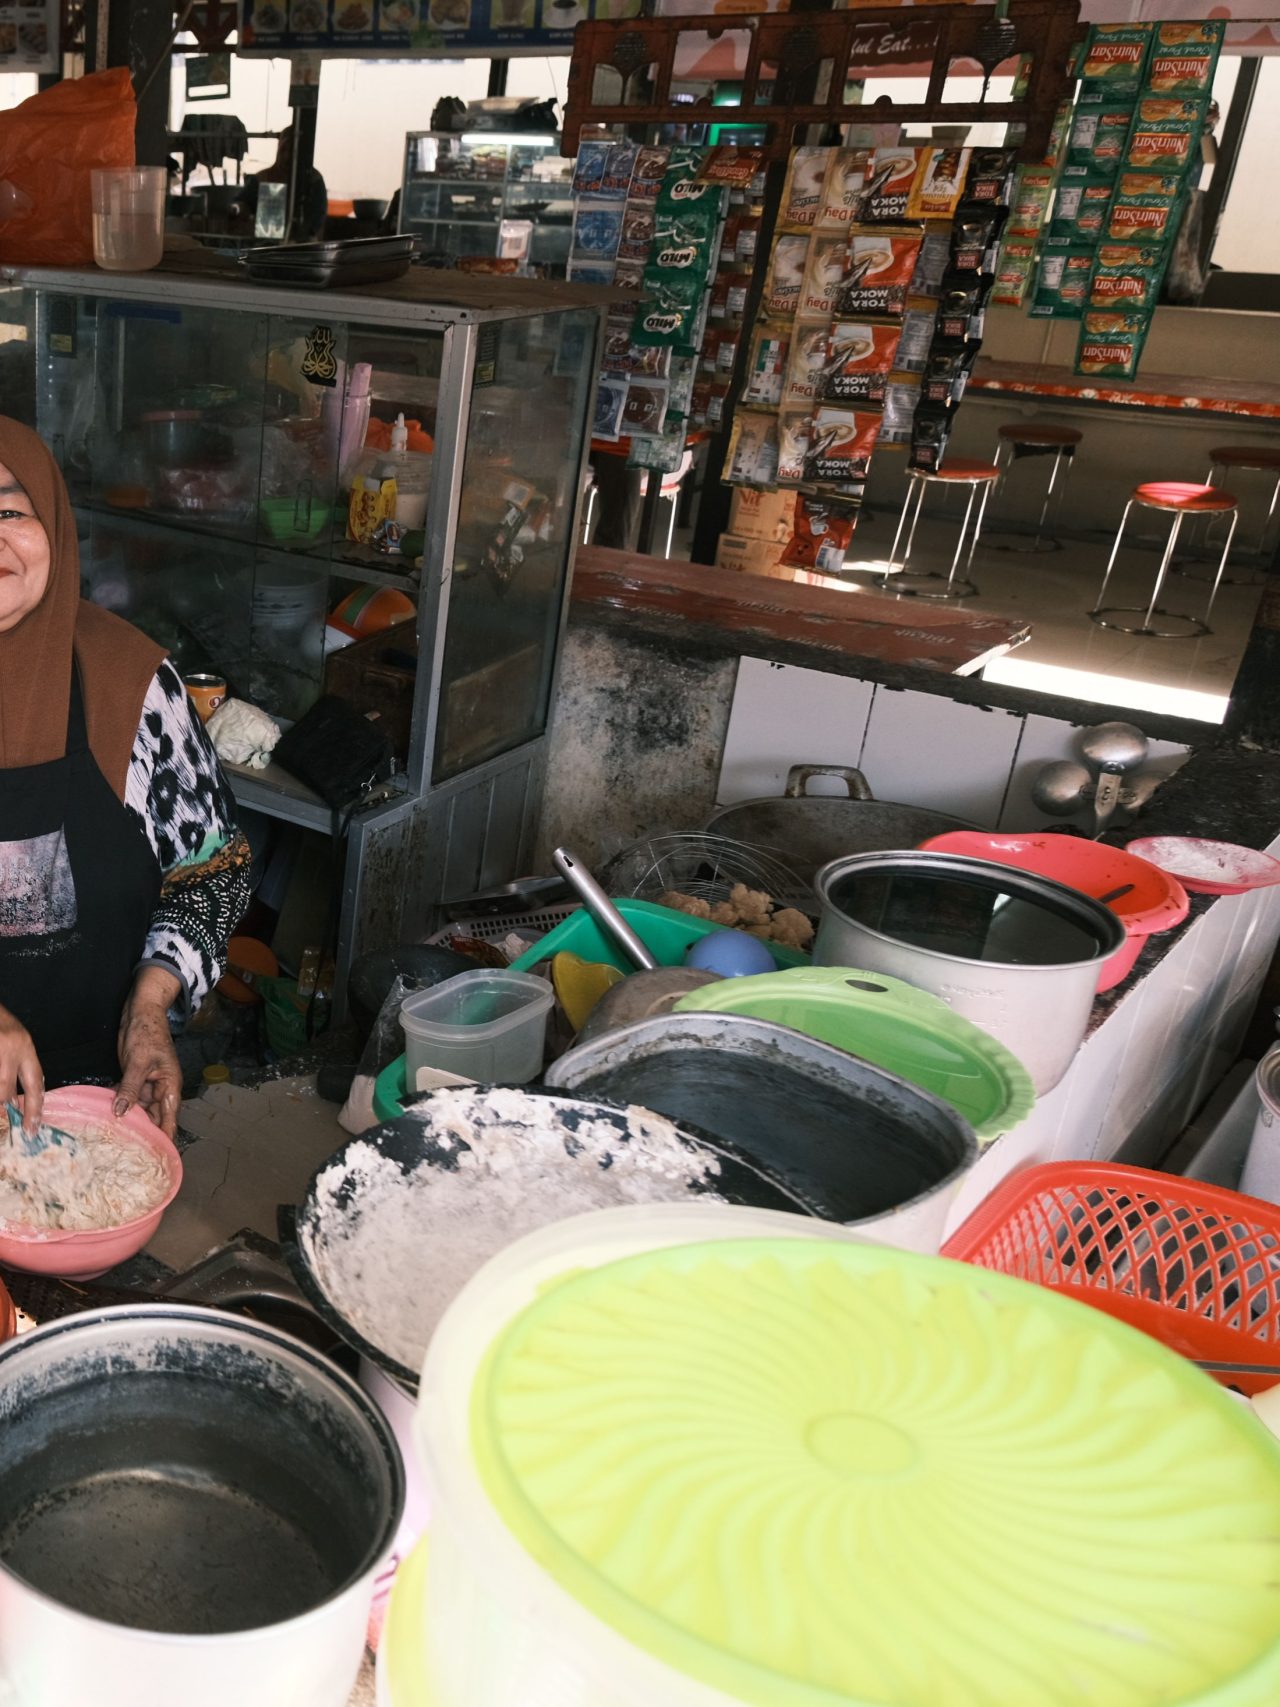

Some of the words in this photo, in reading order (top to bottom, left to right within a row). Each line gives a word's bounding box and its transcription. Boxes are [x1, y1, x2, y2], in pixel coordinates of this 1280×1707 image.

[1089, 44, 1142, 62] NutriSari
[1155, 57, 1208, 78] NutriSari
[1134, 135, 1187, 154] NutriSari
[673, 183, 705, 194] MILO
[1114, 207, 1166, 227] NutriSari
[660, 251, 691, 264] MILO
[1094, 278, 1143, 296] NutriSari
[850, 289, 889, 299] MOKA
[852, 298, 887, 308] TORA
[646, 317, 675, 329] MILO
[1083, 346, 1131, 363] NutriSari
[833, 376, 870, 385] MOKA
[834, 385, 868, 394] TORA
[816, 459, 851, 469] MOKA
[778, 466, 801, 480] Day
[818, 468, 851, 477] TORA
